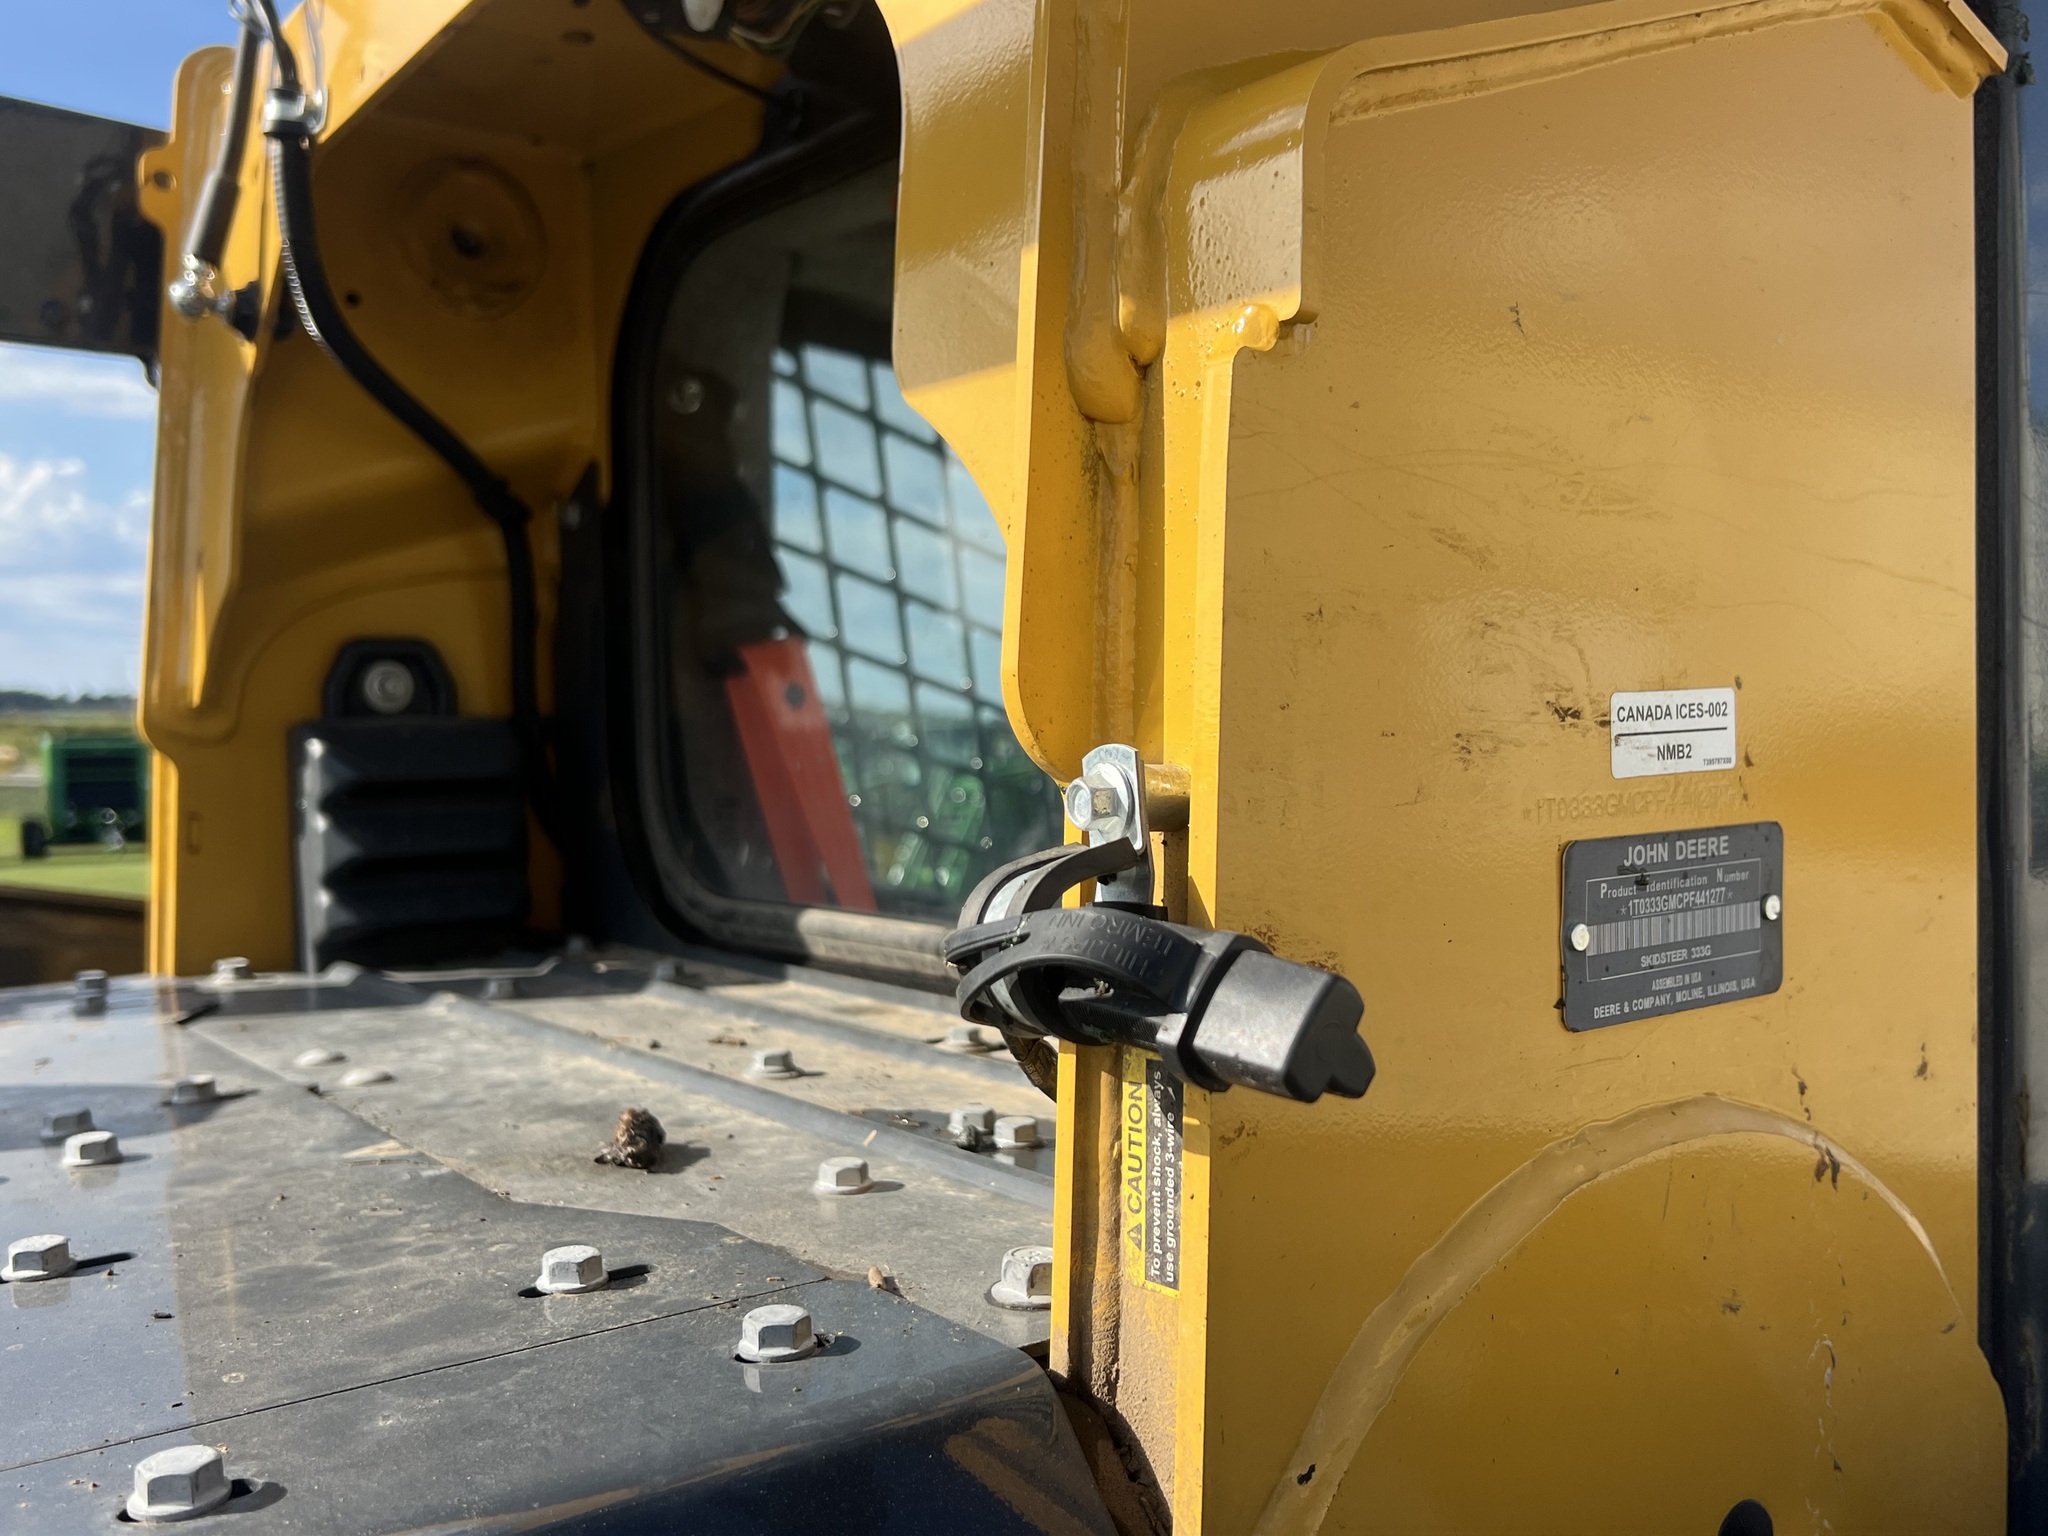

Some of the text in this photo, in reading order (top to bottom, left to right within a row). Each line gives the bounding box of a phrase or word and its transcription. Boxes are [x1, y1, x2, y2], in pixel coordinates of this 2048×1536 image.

[1617, 701, 1728, 723] CANADA ICES-002
[1657, 743, 1692, 761] NMB2
[1623, 836, 1729, 867] JOHN DEERE
[1600, 867, 1750, 899] Product Identification Number
[1640, 944, 1711, 968] SKIDSTEER 333G
[1651, 972, 1702, 991] ASSEMBLED IN USA
[1593, 978, 1756, 1019] DEERE & COMPANY, MOLINE, ILLINOIS, USA
[1127, 1081, 1143, 1214] CAUTION
[1150, 1071, 1163, 1277] To prevent shock, always
[1164, 1112, 1176, 1282] use grounded 3-wire
